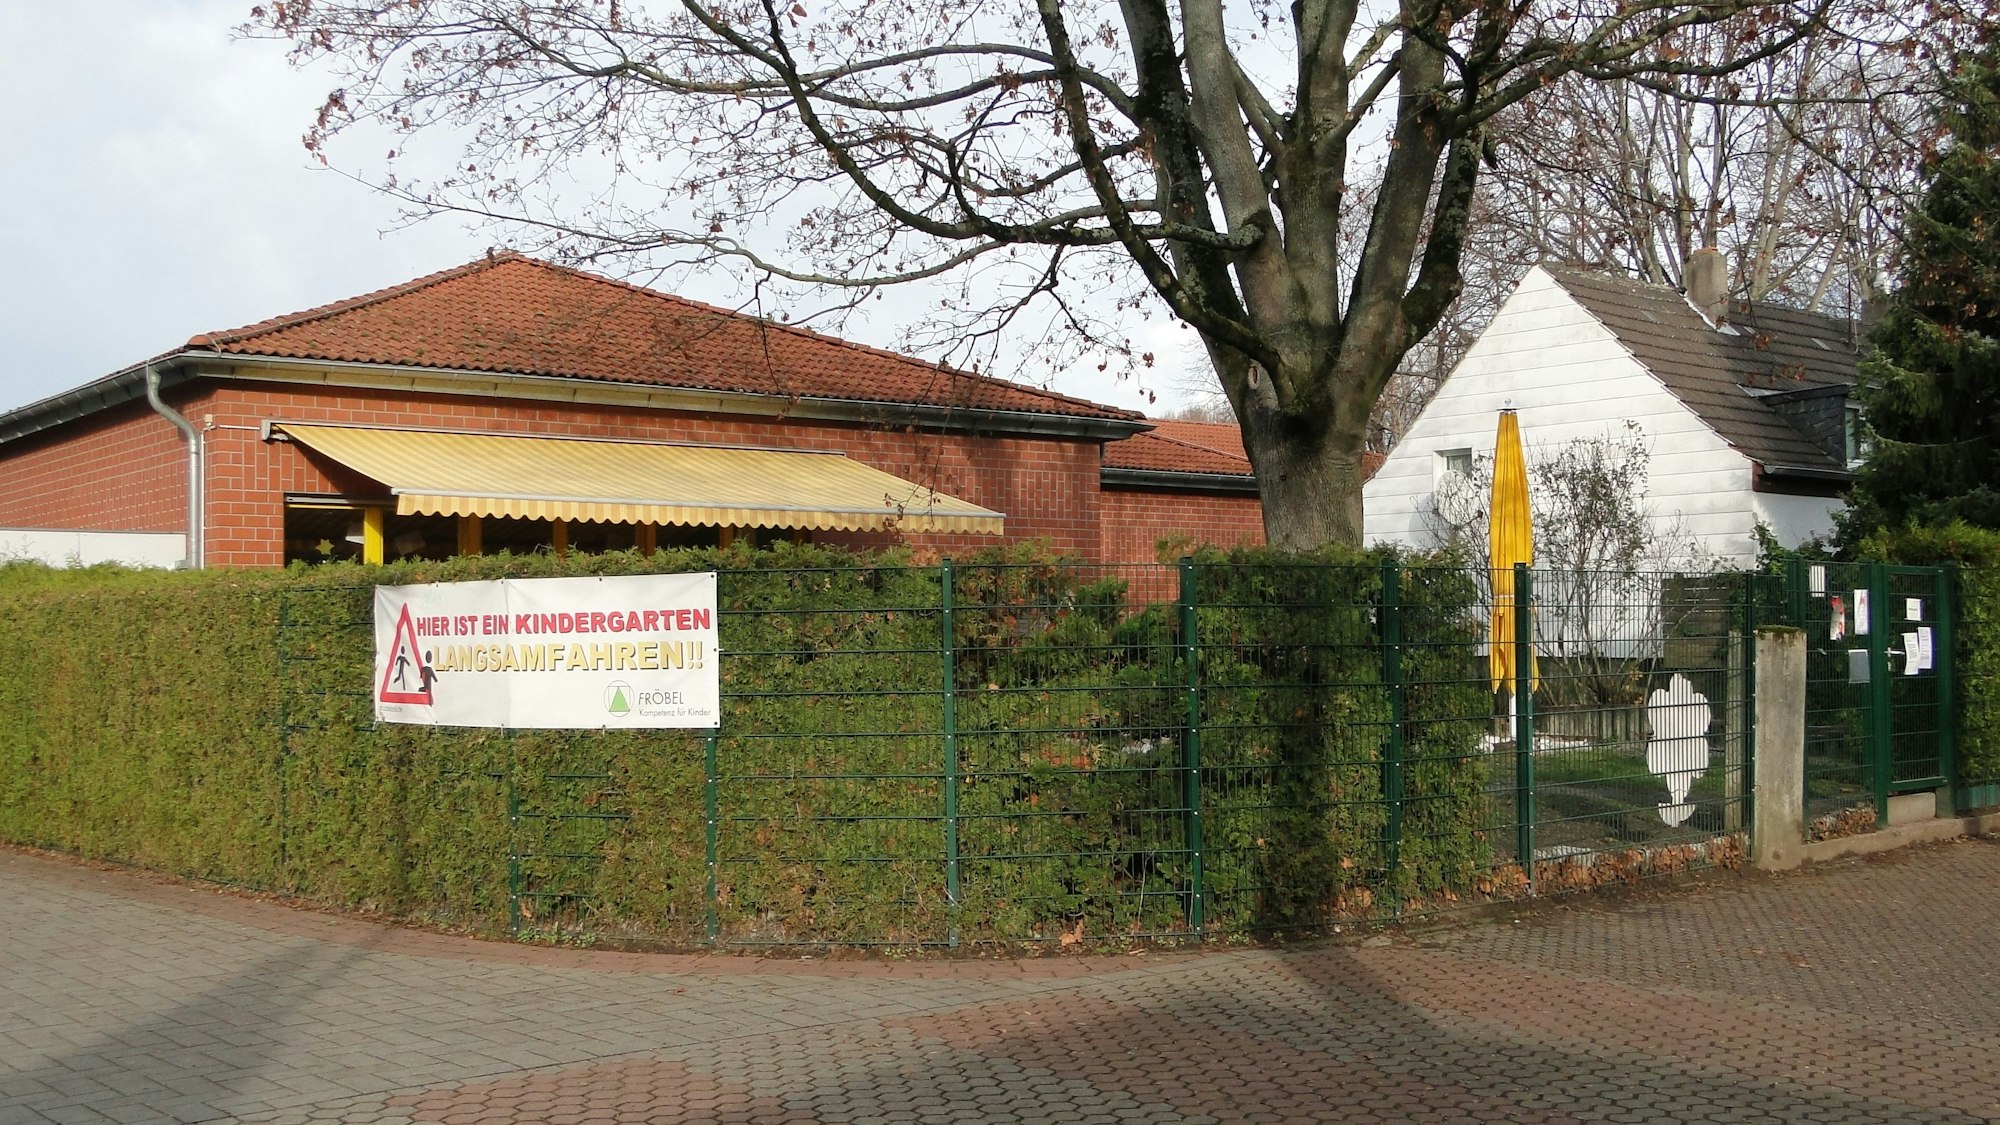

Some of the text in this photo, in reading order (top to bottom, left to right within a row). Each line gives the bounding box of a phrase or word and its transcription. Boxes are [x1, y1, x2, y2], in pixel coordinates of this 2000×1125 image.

[417, 608, 711, 637] HIER IST EIN KINDERGARTEN
[638, 688, 684, 705] FRÖBEL
[639, 707, 711, 718] Kompetenz für Kinder
